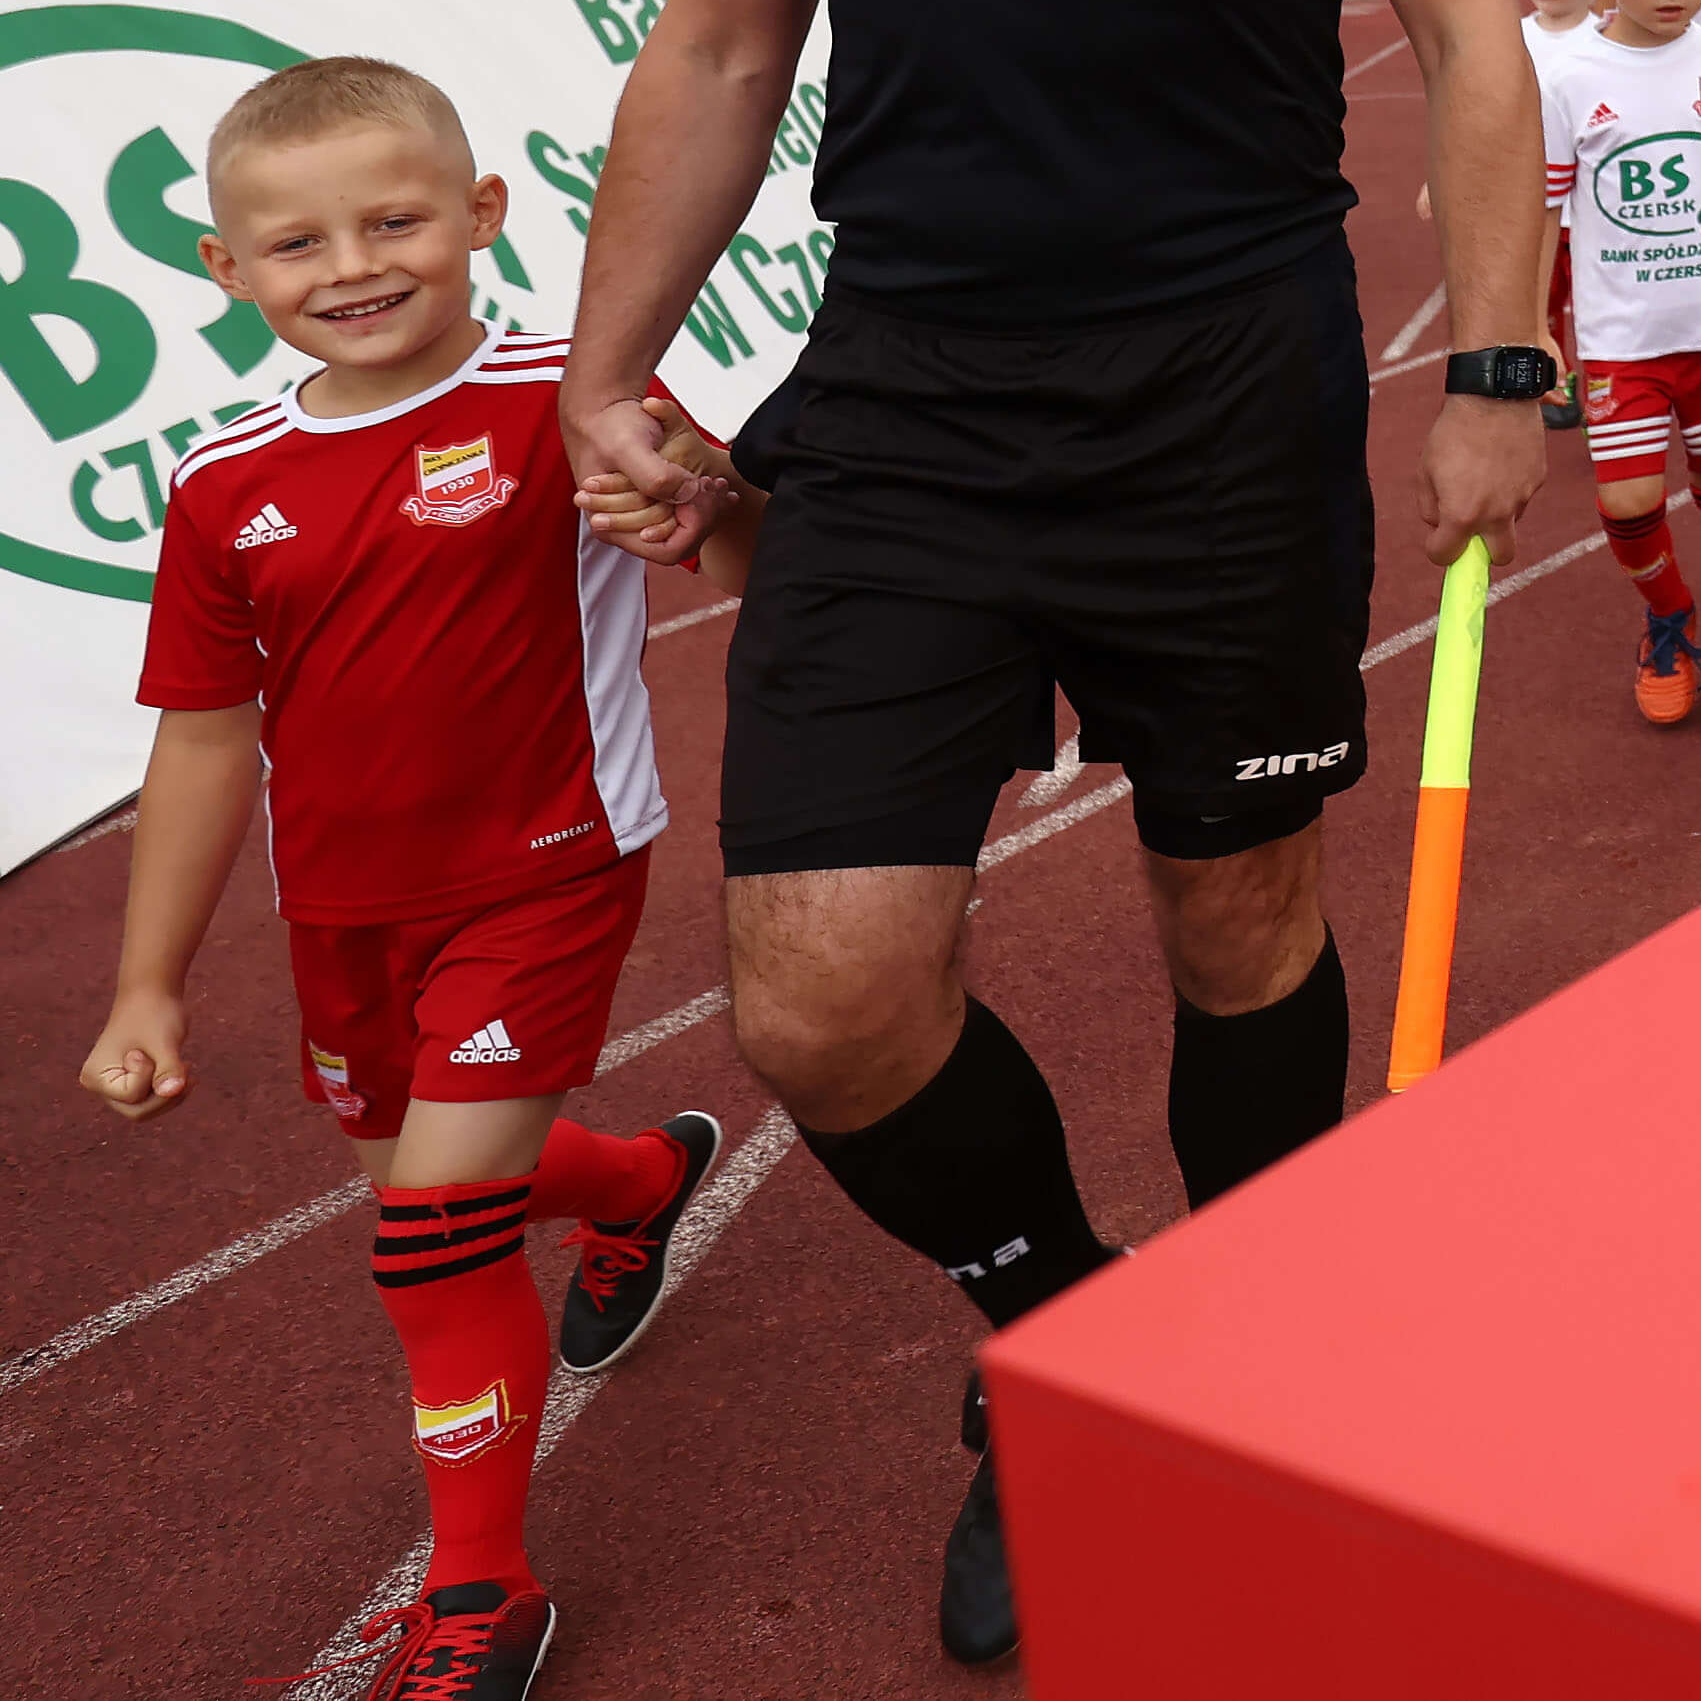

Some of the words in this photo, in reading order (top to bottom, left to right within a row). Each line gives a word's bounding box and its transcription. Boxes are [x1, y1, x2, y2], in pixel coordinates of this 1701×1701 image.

[1618, 153, 1691, 202] BS
[1617, 199, 1695, 220] CZERSK
[1600, 247, 1639, 263] BANK
[1636, 269, 1652, 283] W
[441, 475, 476, 495] 1930
[234, 523, 299, 550] adidas
[1234, 740, 1350, 781] zina
[530, 820, 595, 850] AEROREADY
[449, 1040, 522, 1064] adidas
[433, 1421, 485, 1447] 1930
